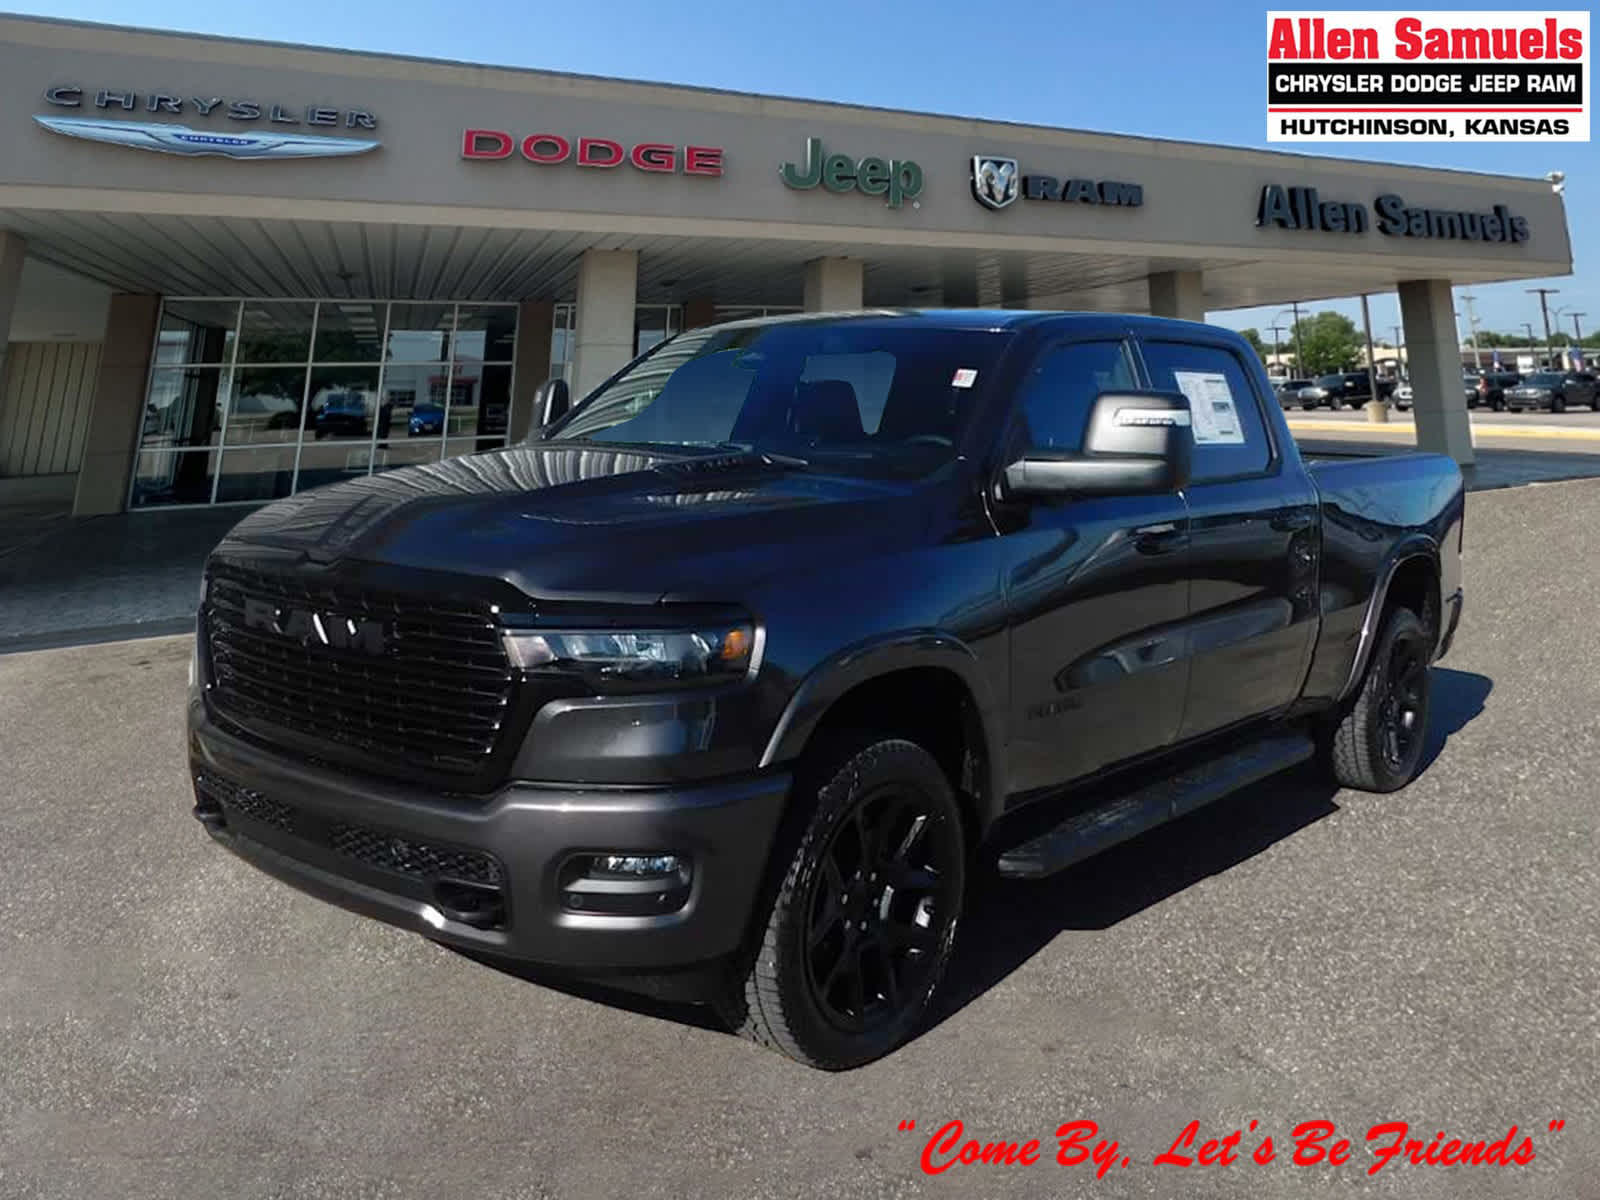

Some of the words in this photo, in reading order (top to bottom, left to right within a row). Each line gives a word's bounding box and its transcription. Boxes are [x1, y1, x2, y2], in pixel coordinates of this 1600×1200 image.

[44, 86, 377, 129] CHRYSLER
[462, 128, 724, 177] DODGE
[780, 137, 924, 208] Jeep
[1023, 175, 1143, 207] RAM
[1256, 184, 1369, 233] Allen
[1374, 194, 1531, 243] Samuels
